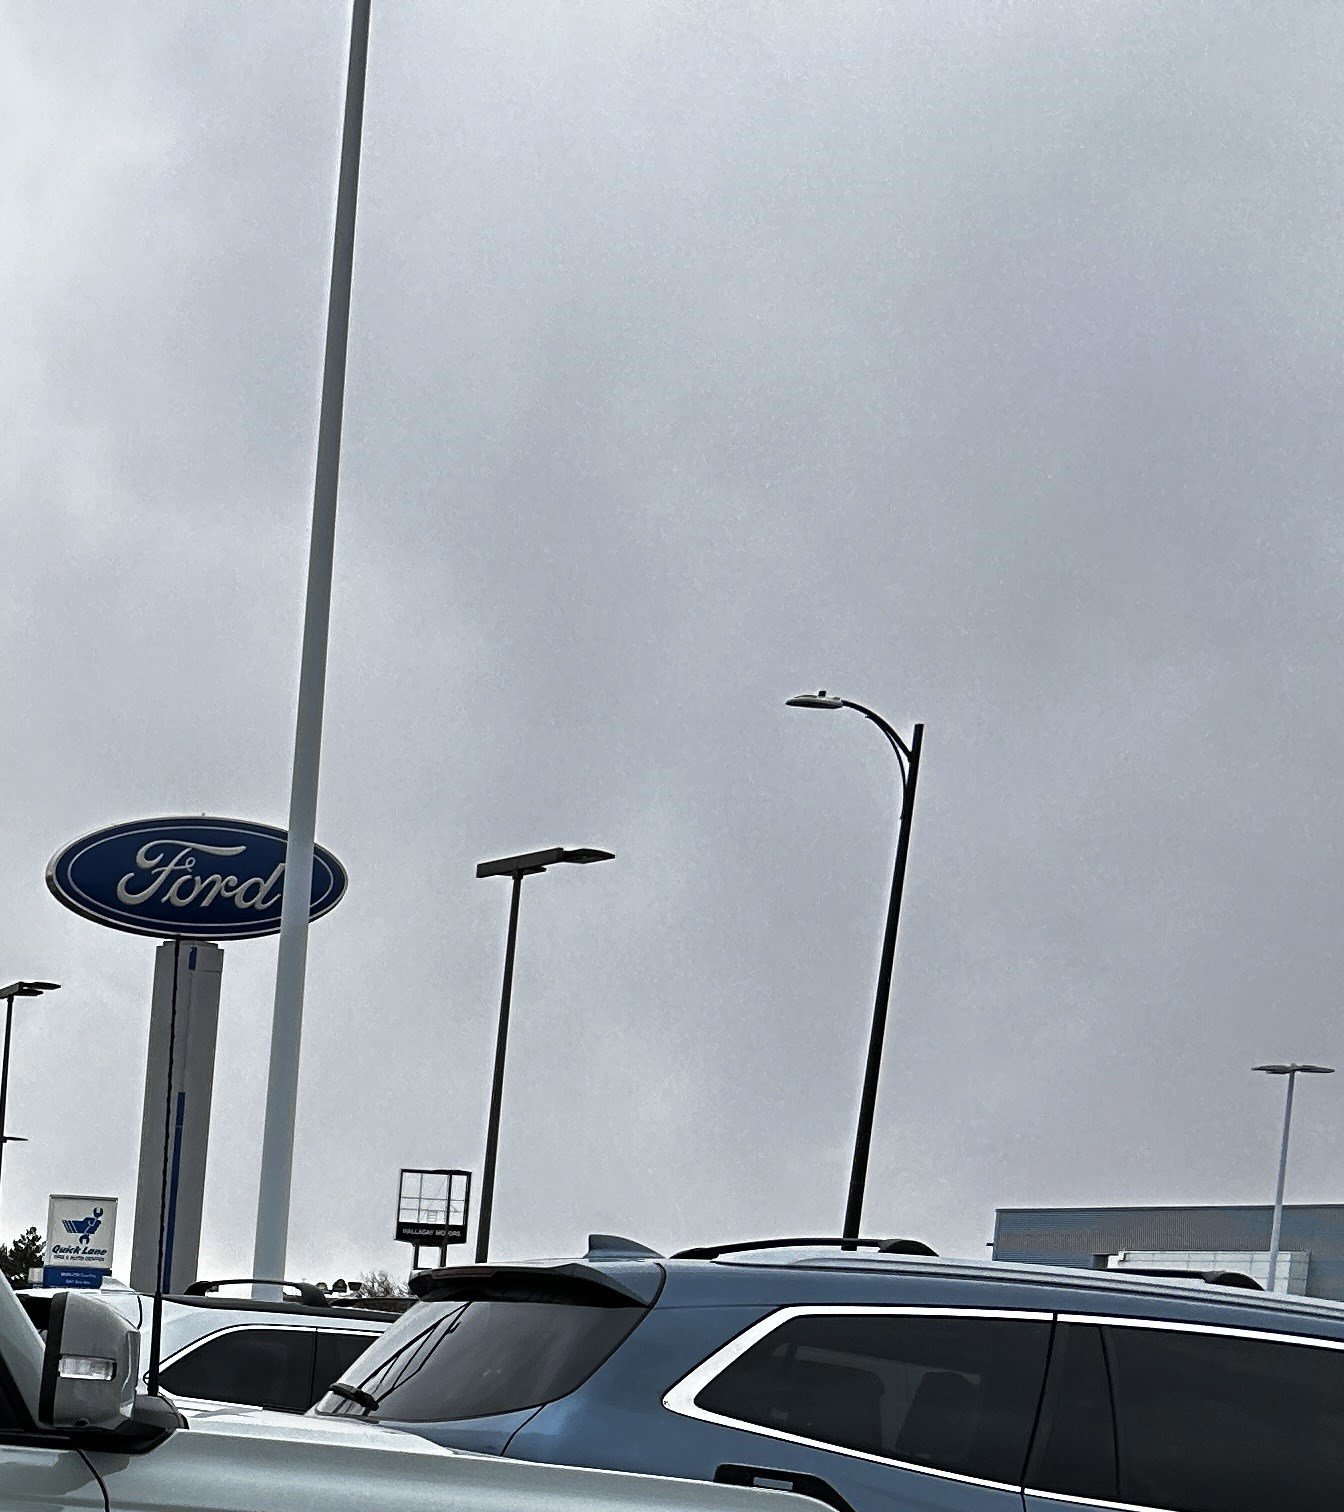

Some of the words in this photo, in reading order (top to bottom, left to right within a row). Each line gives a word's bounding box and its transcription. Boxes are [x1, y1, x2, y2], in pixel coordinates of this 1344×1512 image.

[116, 839, 287, 910] Ford
[52, 1244, 81, 1254] Quick
[82, 1246, 108, 1256] Lane
